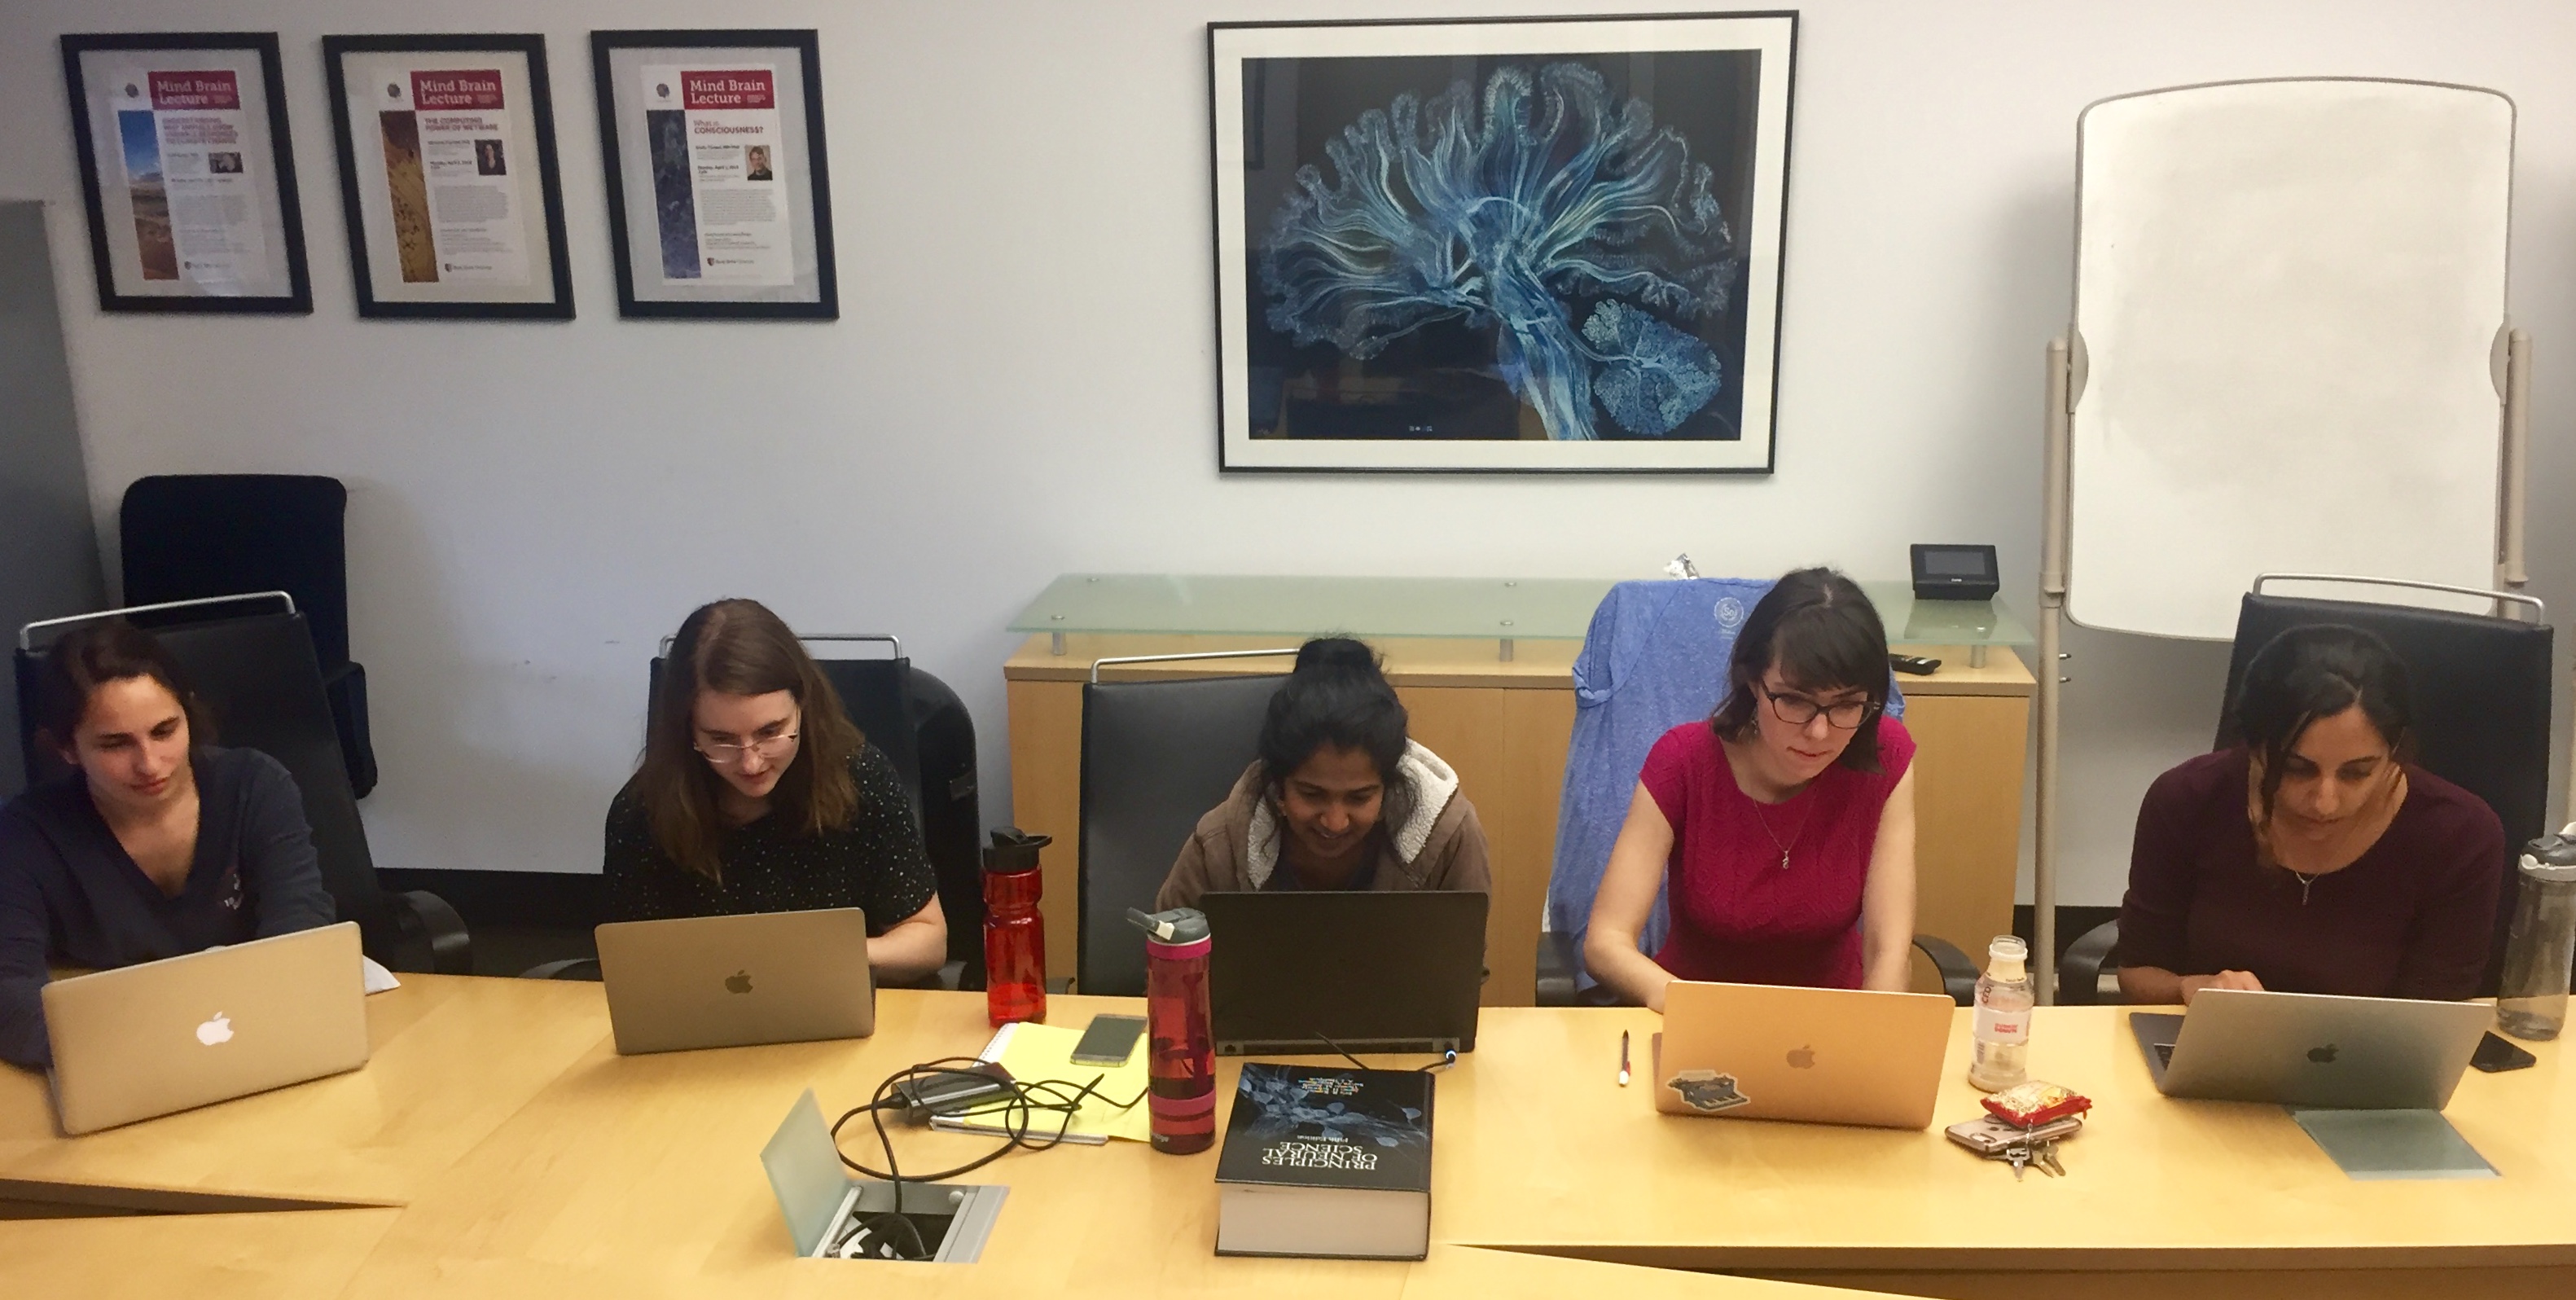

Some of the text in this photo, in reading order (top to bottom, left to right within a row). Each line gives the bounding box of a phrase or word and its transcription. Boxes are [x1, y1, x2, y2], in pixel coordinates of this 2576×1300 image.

[157, 80, 231, 91] Mind Brain
[420, 79, 496, 91] Mind Brain
[690, 79, 766, 91] Mind Brain
[159, 94, 208, 104] Lecture
[421, 92, 472, 104] Lecture
[691, 93, 741, 104] Lecture
[694, 126, 764, 134] CONSCIOUSNESS?
[1297, 1135, 1327, 1143] Edition
[1279, 1141, 1363, 1154] SCIENCE
[1262, 1148, 1378, 1162] OF NEURAL
[1262, 1155, 1376, 1170] PRINCIPLES
